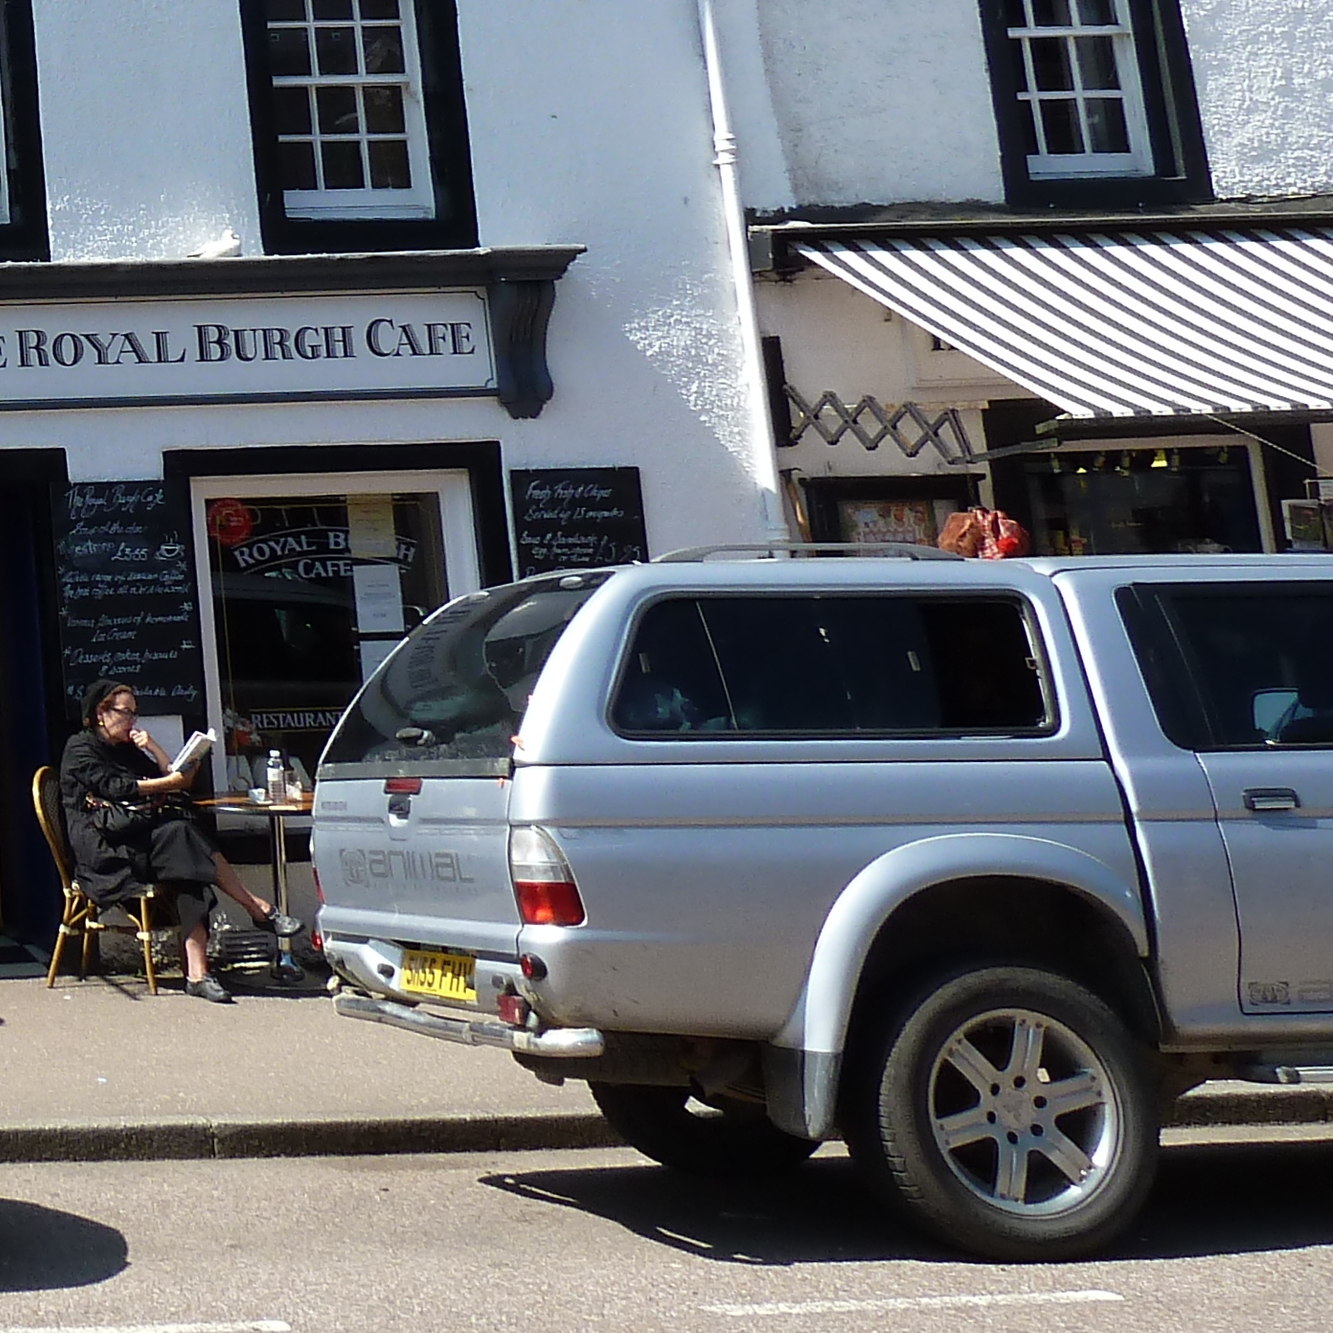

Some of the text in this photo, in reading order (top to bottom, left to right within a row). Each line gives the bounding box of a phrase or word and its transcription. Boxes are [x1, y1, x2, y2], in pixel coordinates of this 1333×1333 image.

[15, 328, 187, 368] ROYAL
[193, 323, 356, 363] BURGH
[365, 317, 476, 358] CAFE
[234, 533, 317, 568] ROYAL
[298, 558, 353, 579] CAFE
